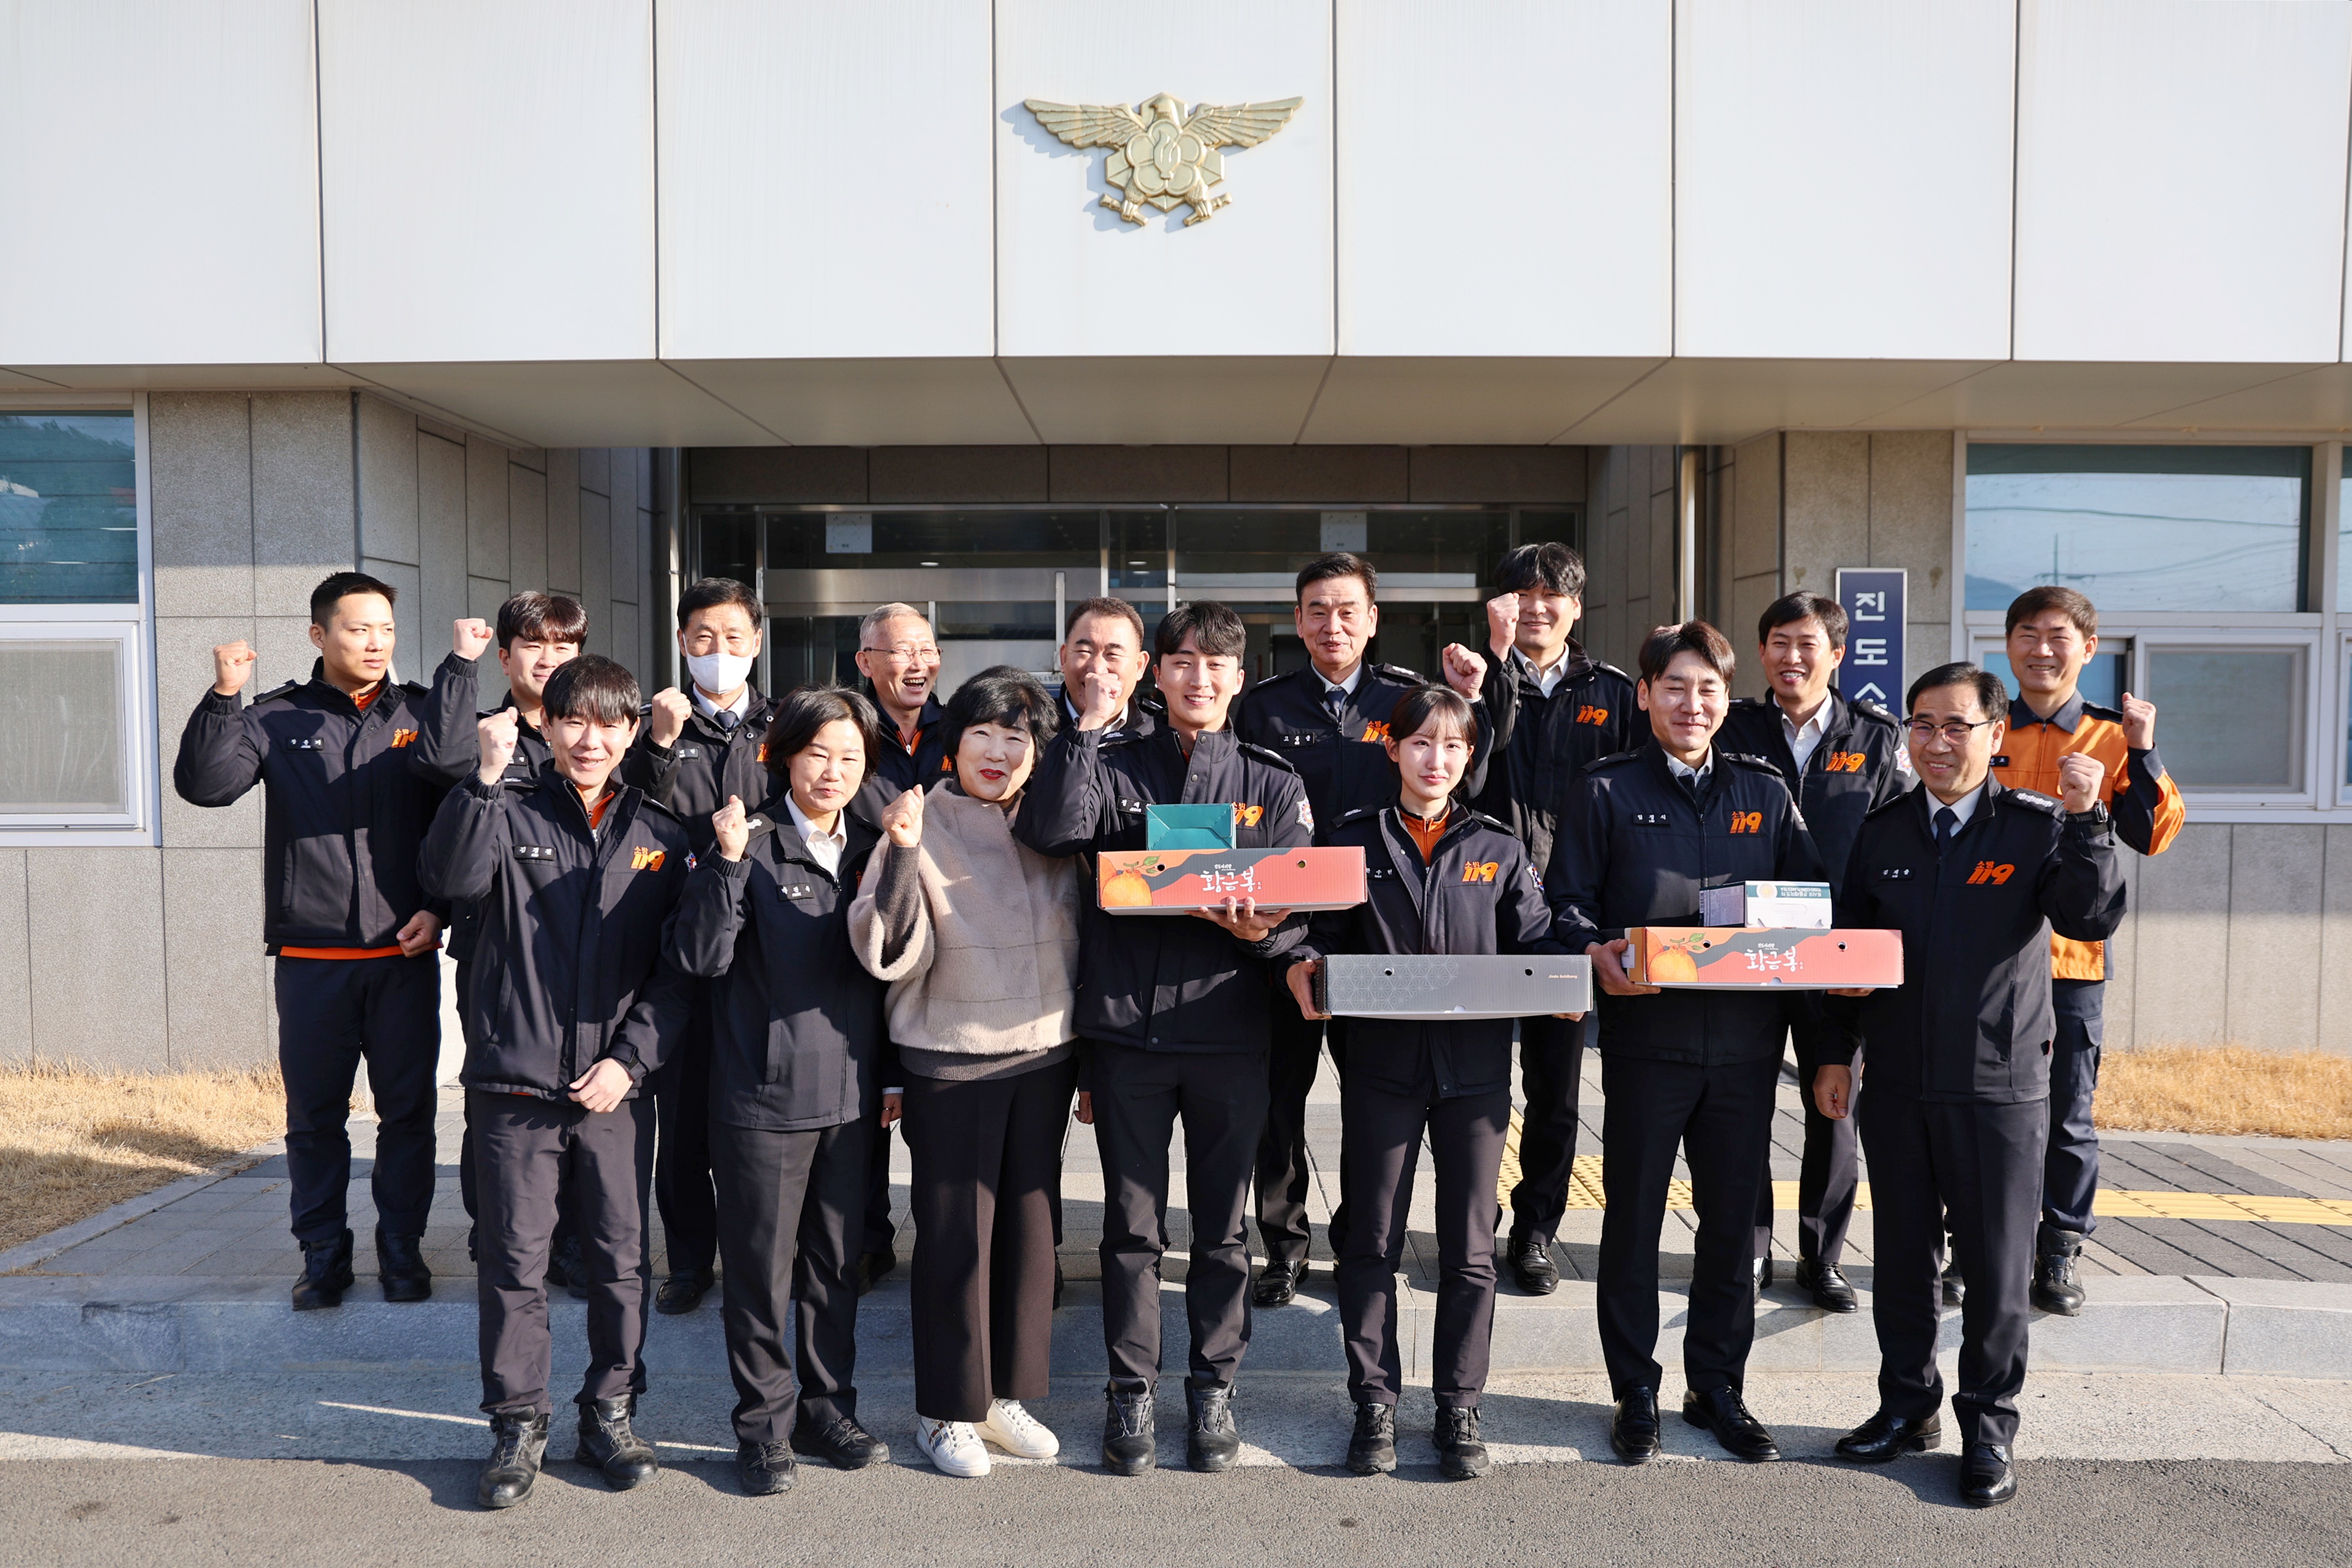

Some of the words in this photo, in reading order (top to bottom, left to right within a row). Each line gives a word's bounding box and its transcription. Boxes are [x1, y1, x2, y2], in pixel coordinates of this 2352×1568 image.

[1576, 708, 1608, 726] 119
[1825, 753, 1867, 772] 119
[1234, 805, 1263, 827] 19
[1729, 812, 1763, 834] 119
[630, 850, 666, 872] 119
[633, 845, 649, 855] 소방
[1200, 865, 1256, 893] 황금봉
[1461, 861, 1500, 882] 119
[1966, 863, 2016, 885] 119
[1744, 945, 1798, 972] 황금봉
